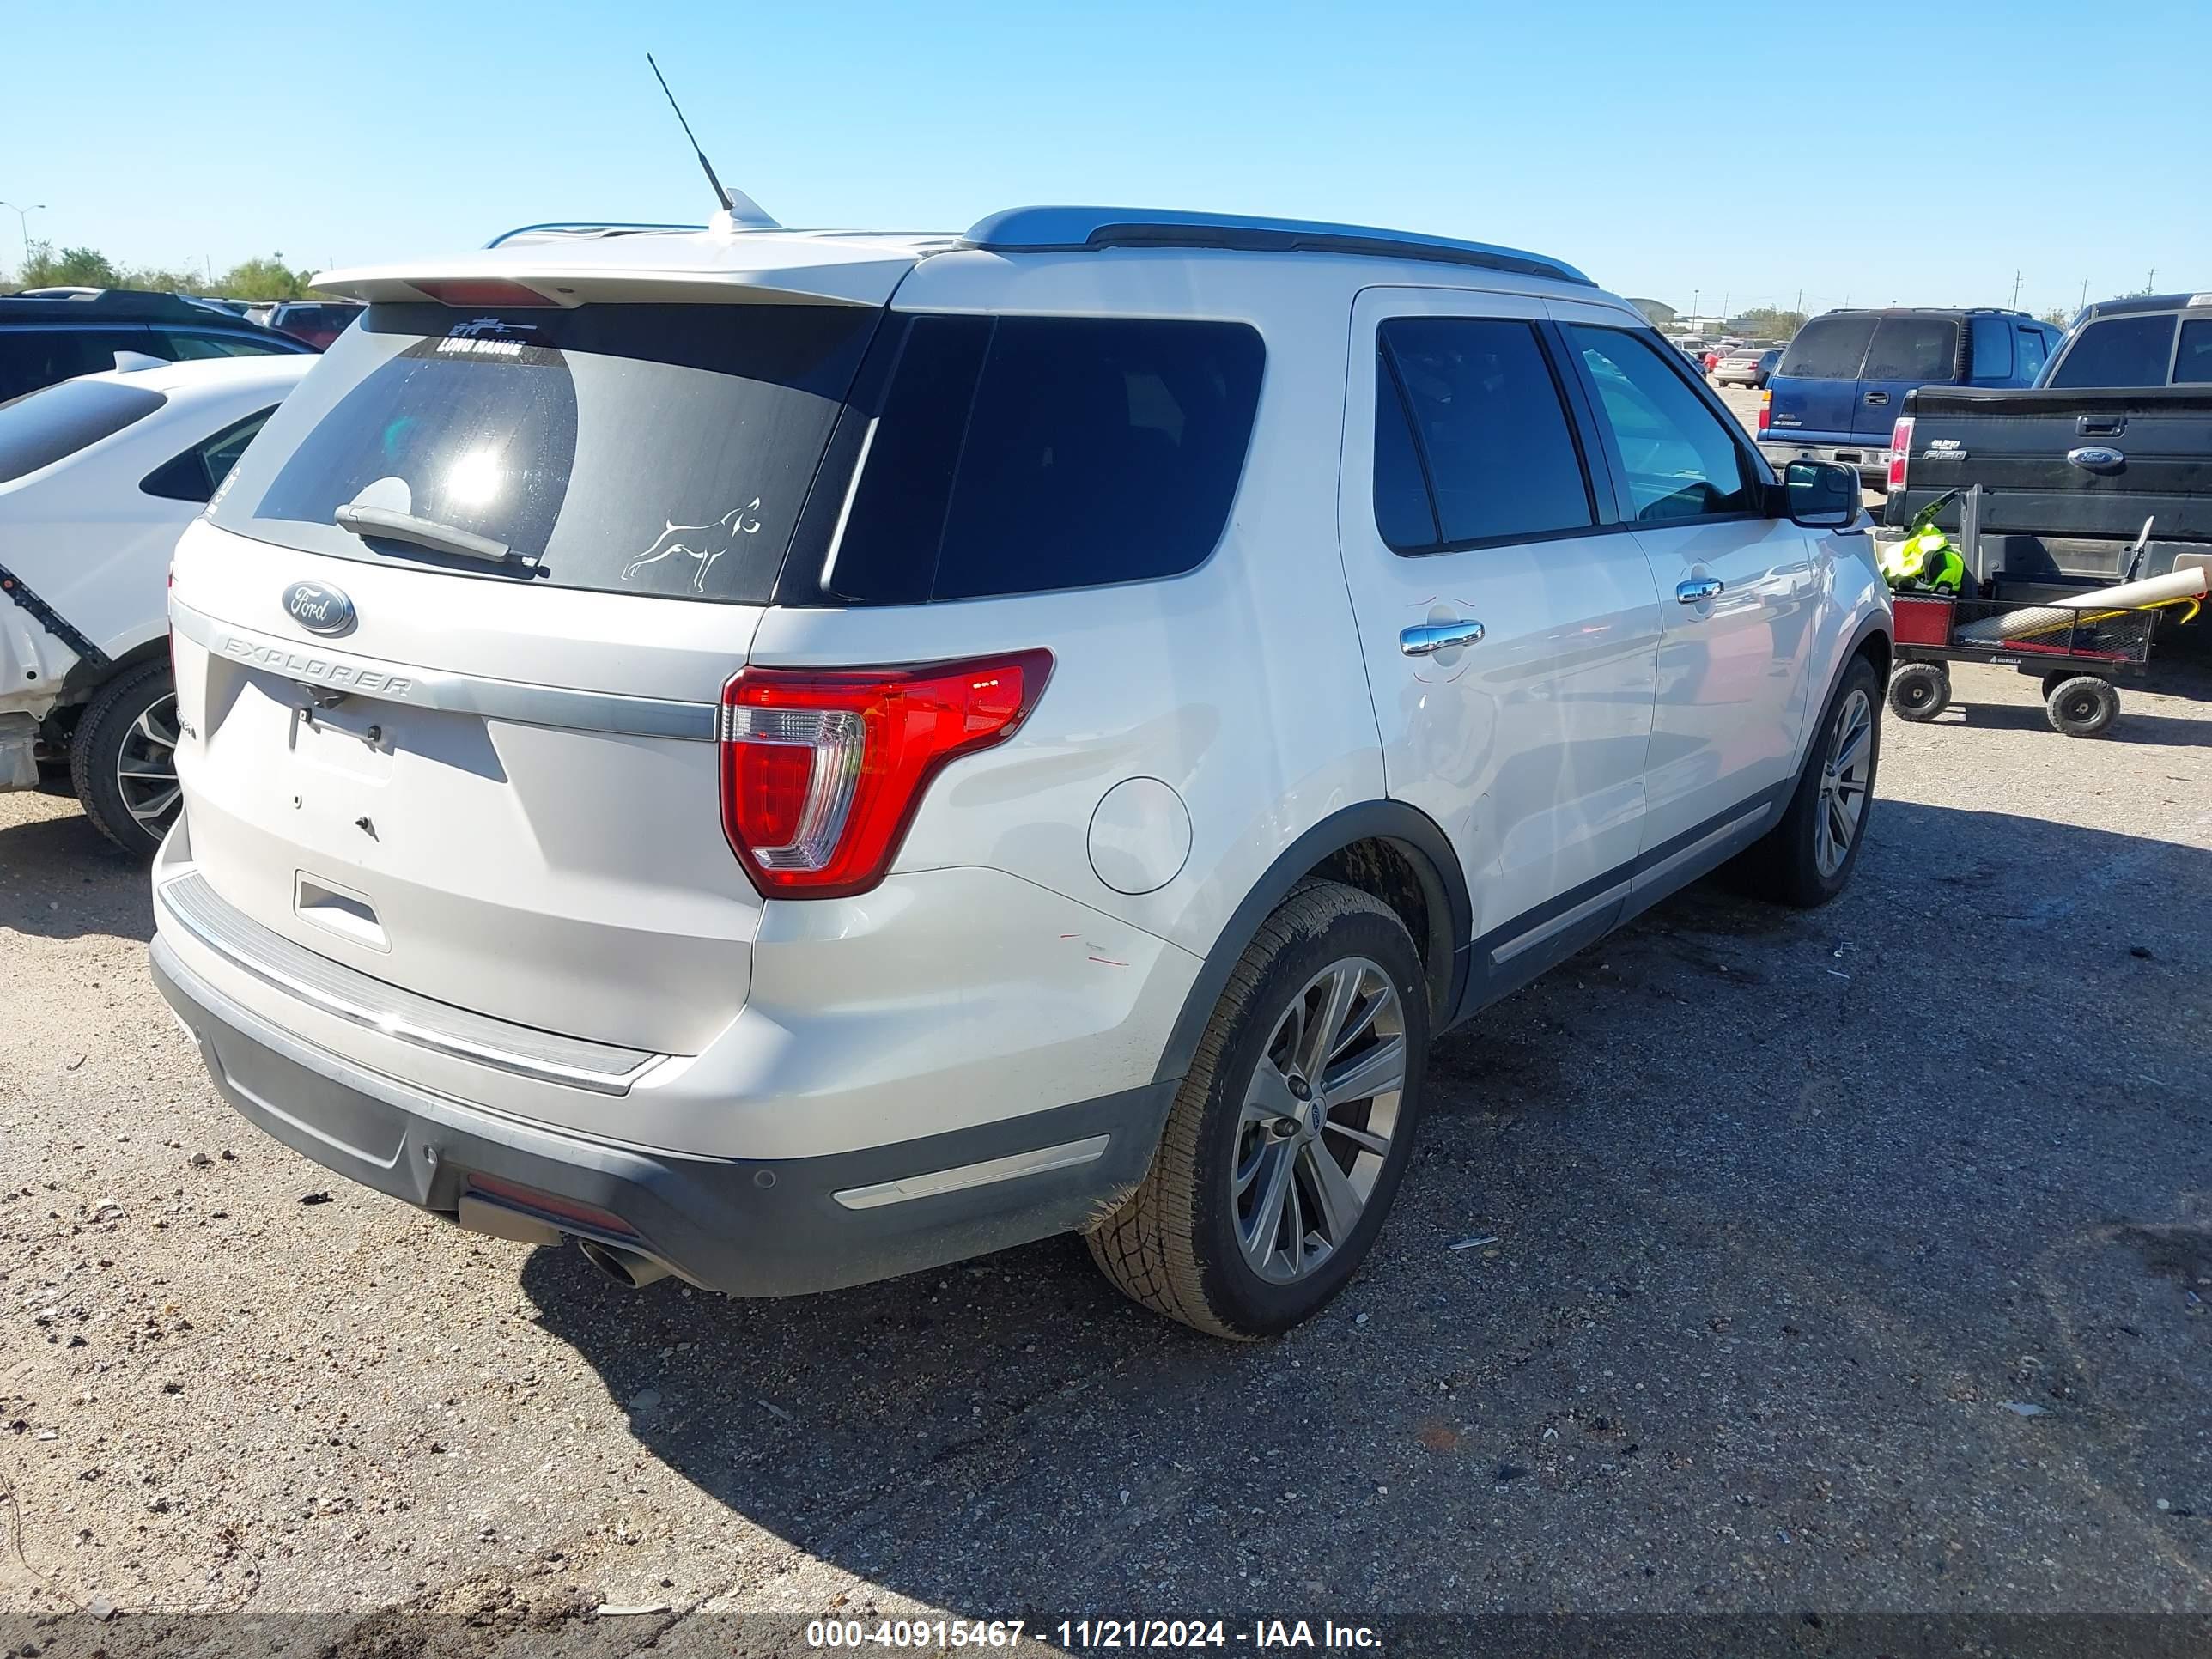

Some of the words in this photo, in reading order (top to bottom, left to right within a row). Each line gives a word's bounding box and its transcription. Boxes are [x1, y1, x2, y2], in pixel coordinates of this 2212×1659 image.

[436, 337, 475, 353] LONG
[290, 586, 331, 622] Ford
[224, 636, 413, 696] EXPLORER
